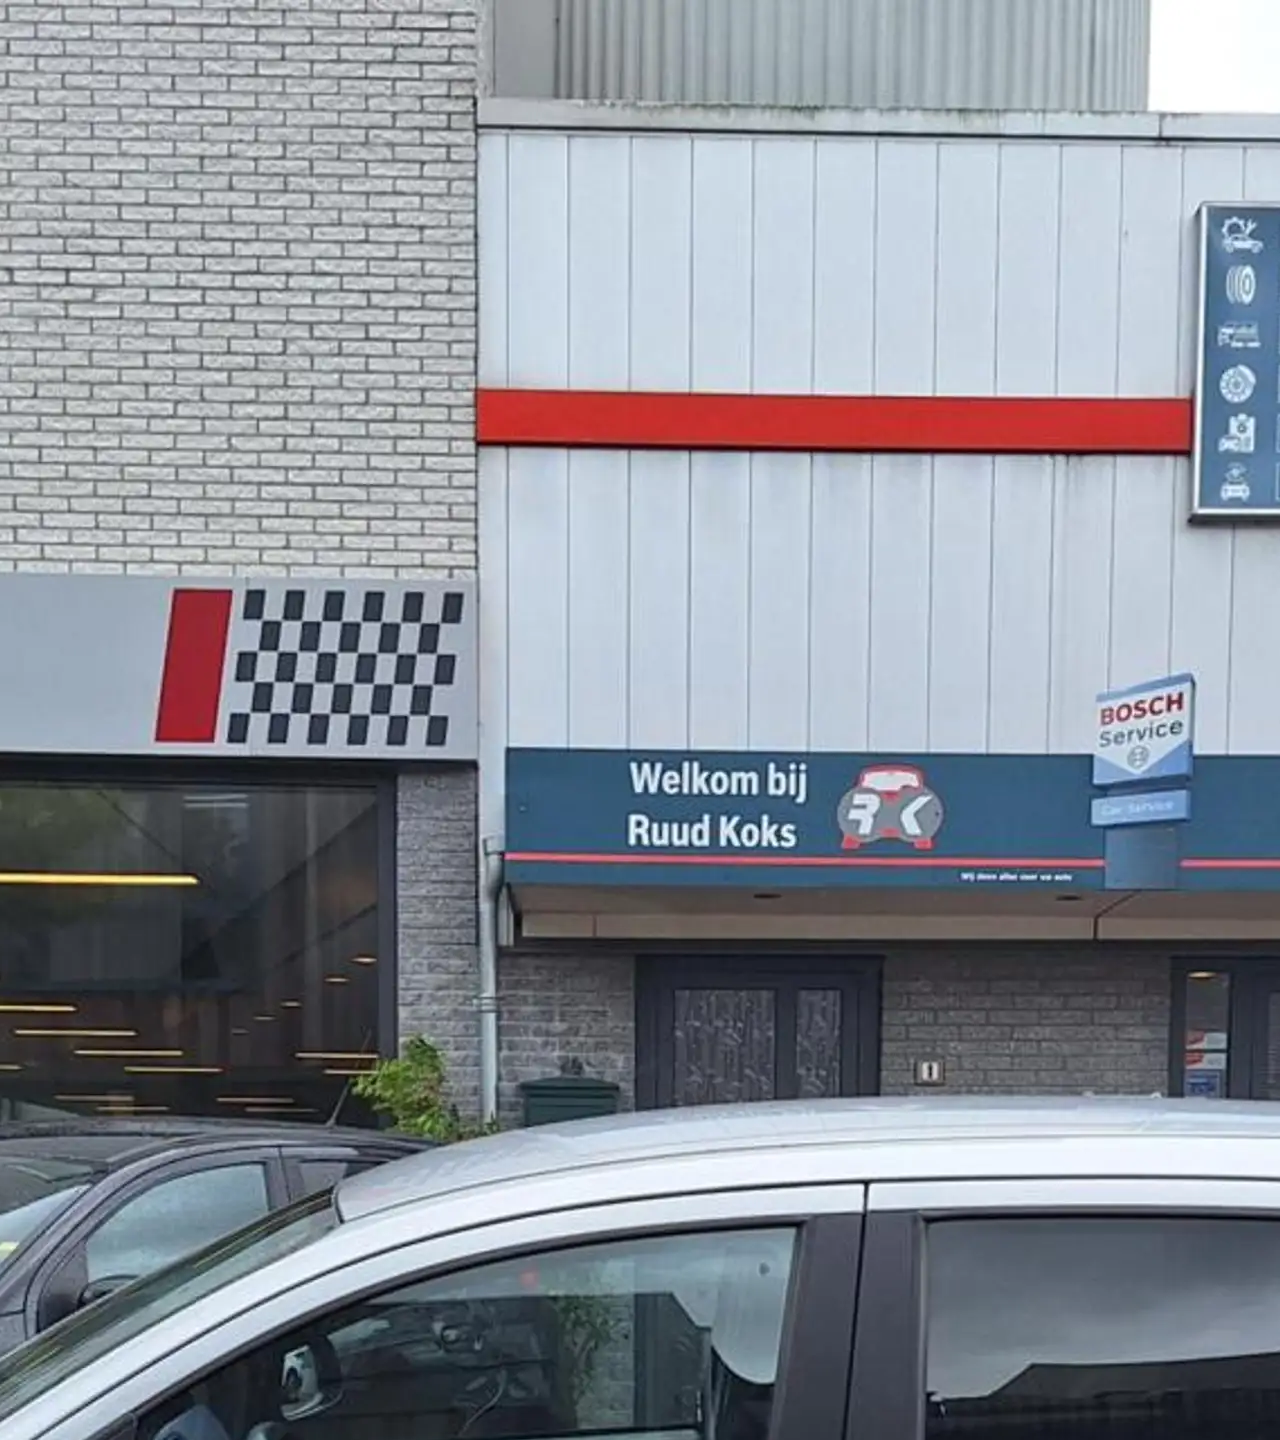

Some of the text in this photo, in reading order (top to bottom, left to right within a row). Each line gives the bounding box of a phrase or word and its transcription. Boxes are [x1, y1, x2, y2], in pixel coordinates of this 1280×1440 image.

[1099, 691, 1185, 727] BOSCH
[1099, 719, 1184, 748] Service
[629, 761, 808, 804] Welkom bij
[628, 814, 797, 848] Ruud Koks
